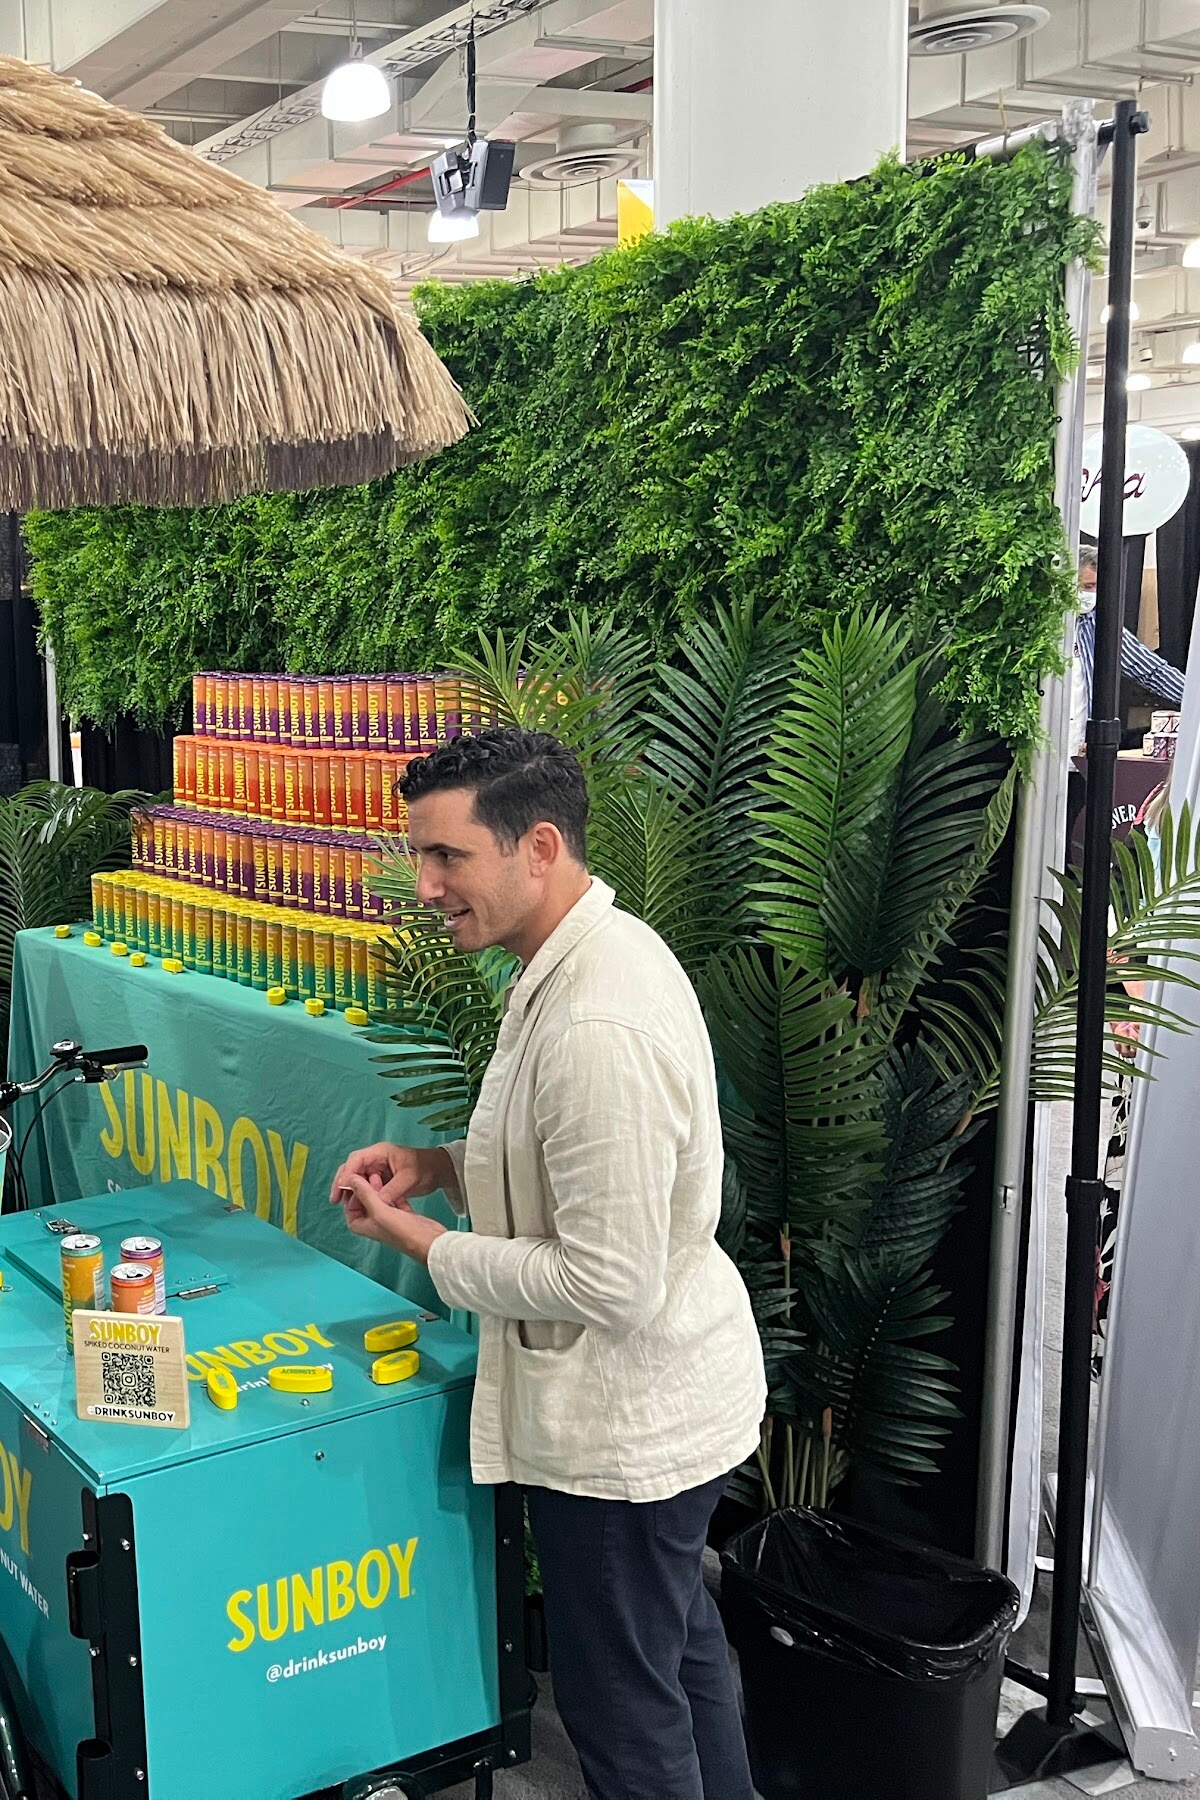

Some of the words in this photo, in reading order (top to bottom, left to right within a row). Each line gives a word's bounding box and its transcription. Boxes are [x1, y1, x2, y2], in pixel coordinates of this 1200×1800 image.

[368, 693, 379, 737] SUNBOY
[235, 759, 245, 799] SUNBOY
[382, 773, 392, 818] SUNBOY
[255, 846, 266, 888] SUNBOY
[196, 917, 206, 960] SUNBOY
[315, 945, 325, 993] SUNBOY
[84, 1340, 108, 1349] SPIKED
[108, 1342, 146, 1352] COCONUT
[147, 1345, 170, 1353] WATER
[88, 1319, 162, 1345] SUNBOY
[185, 1323, 335, 1381] UNBOY
[19, 1570, 50, 1619] WATER
[226, 1536, 418, 1652] SUNBOY
[266, 1635, 387, 1682] @drinksunboy
